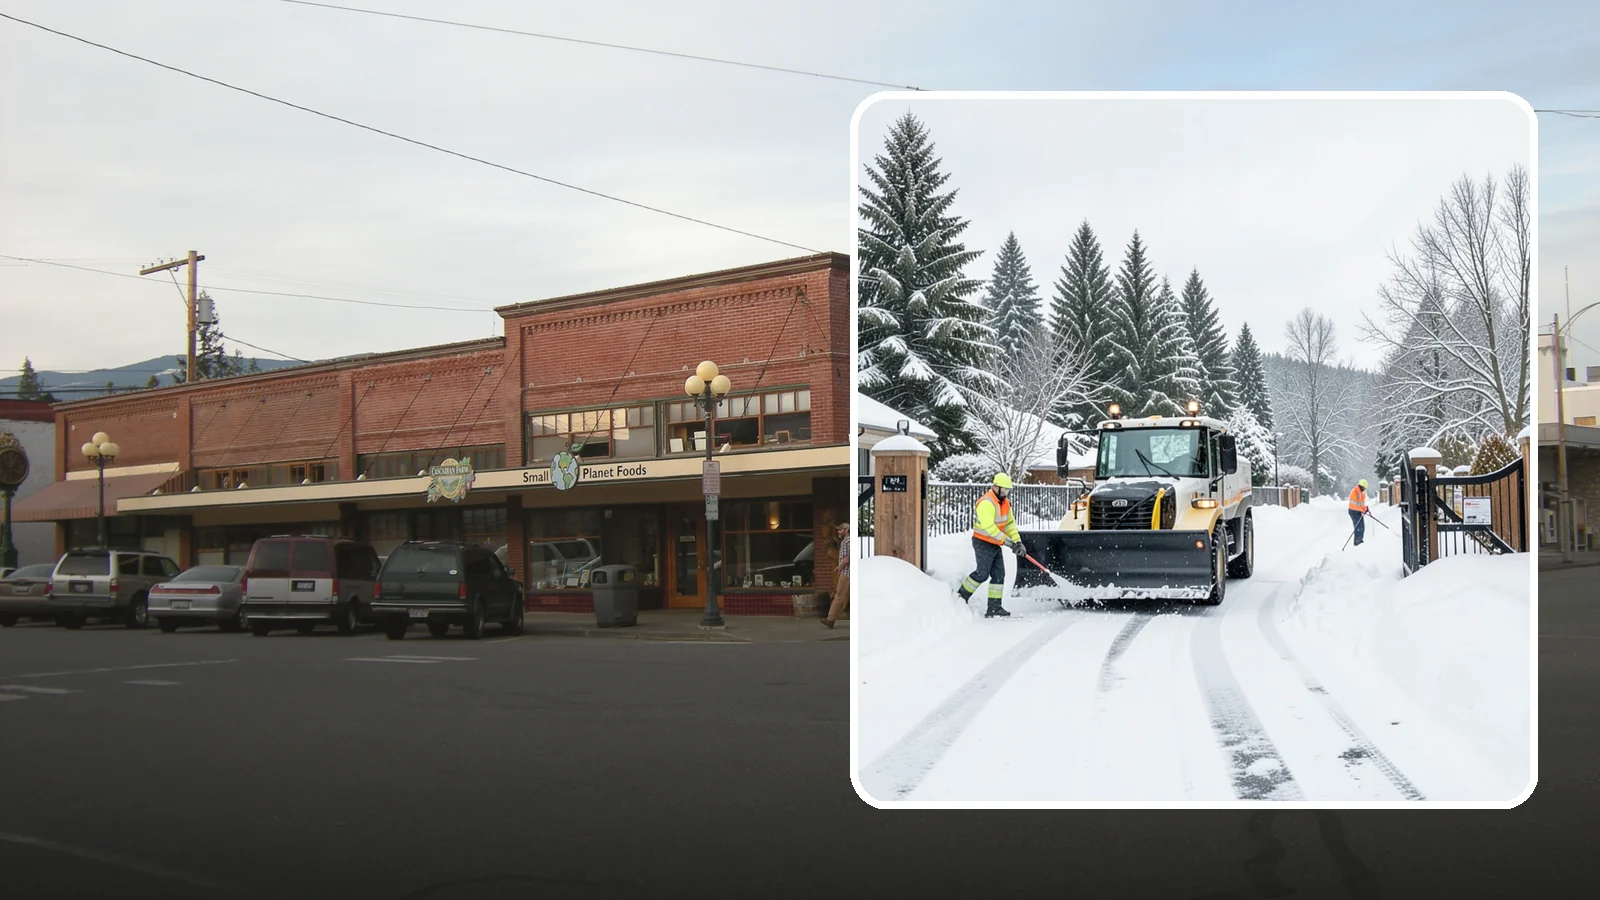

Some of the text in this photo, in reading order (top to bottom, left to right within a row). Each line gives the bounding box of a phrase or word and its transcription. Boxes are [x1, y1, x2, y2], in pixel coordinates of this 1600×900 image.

[523, 464, 647, 483] Small Planet Foods
